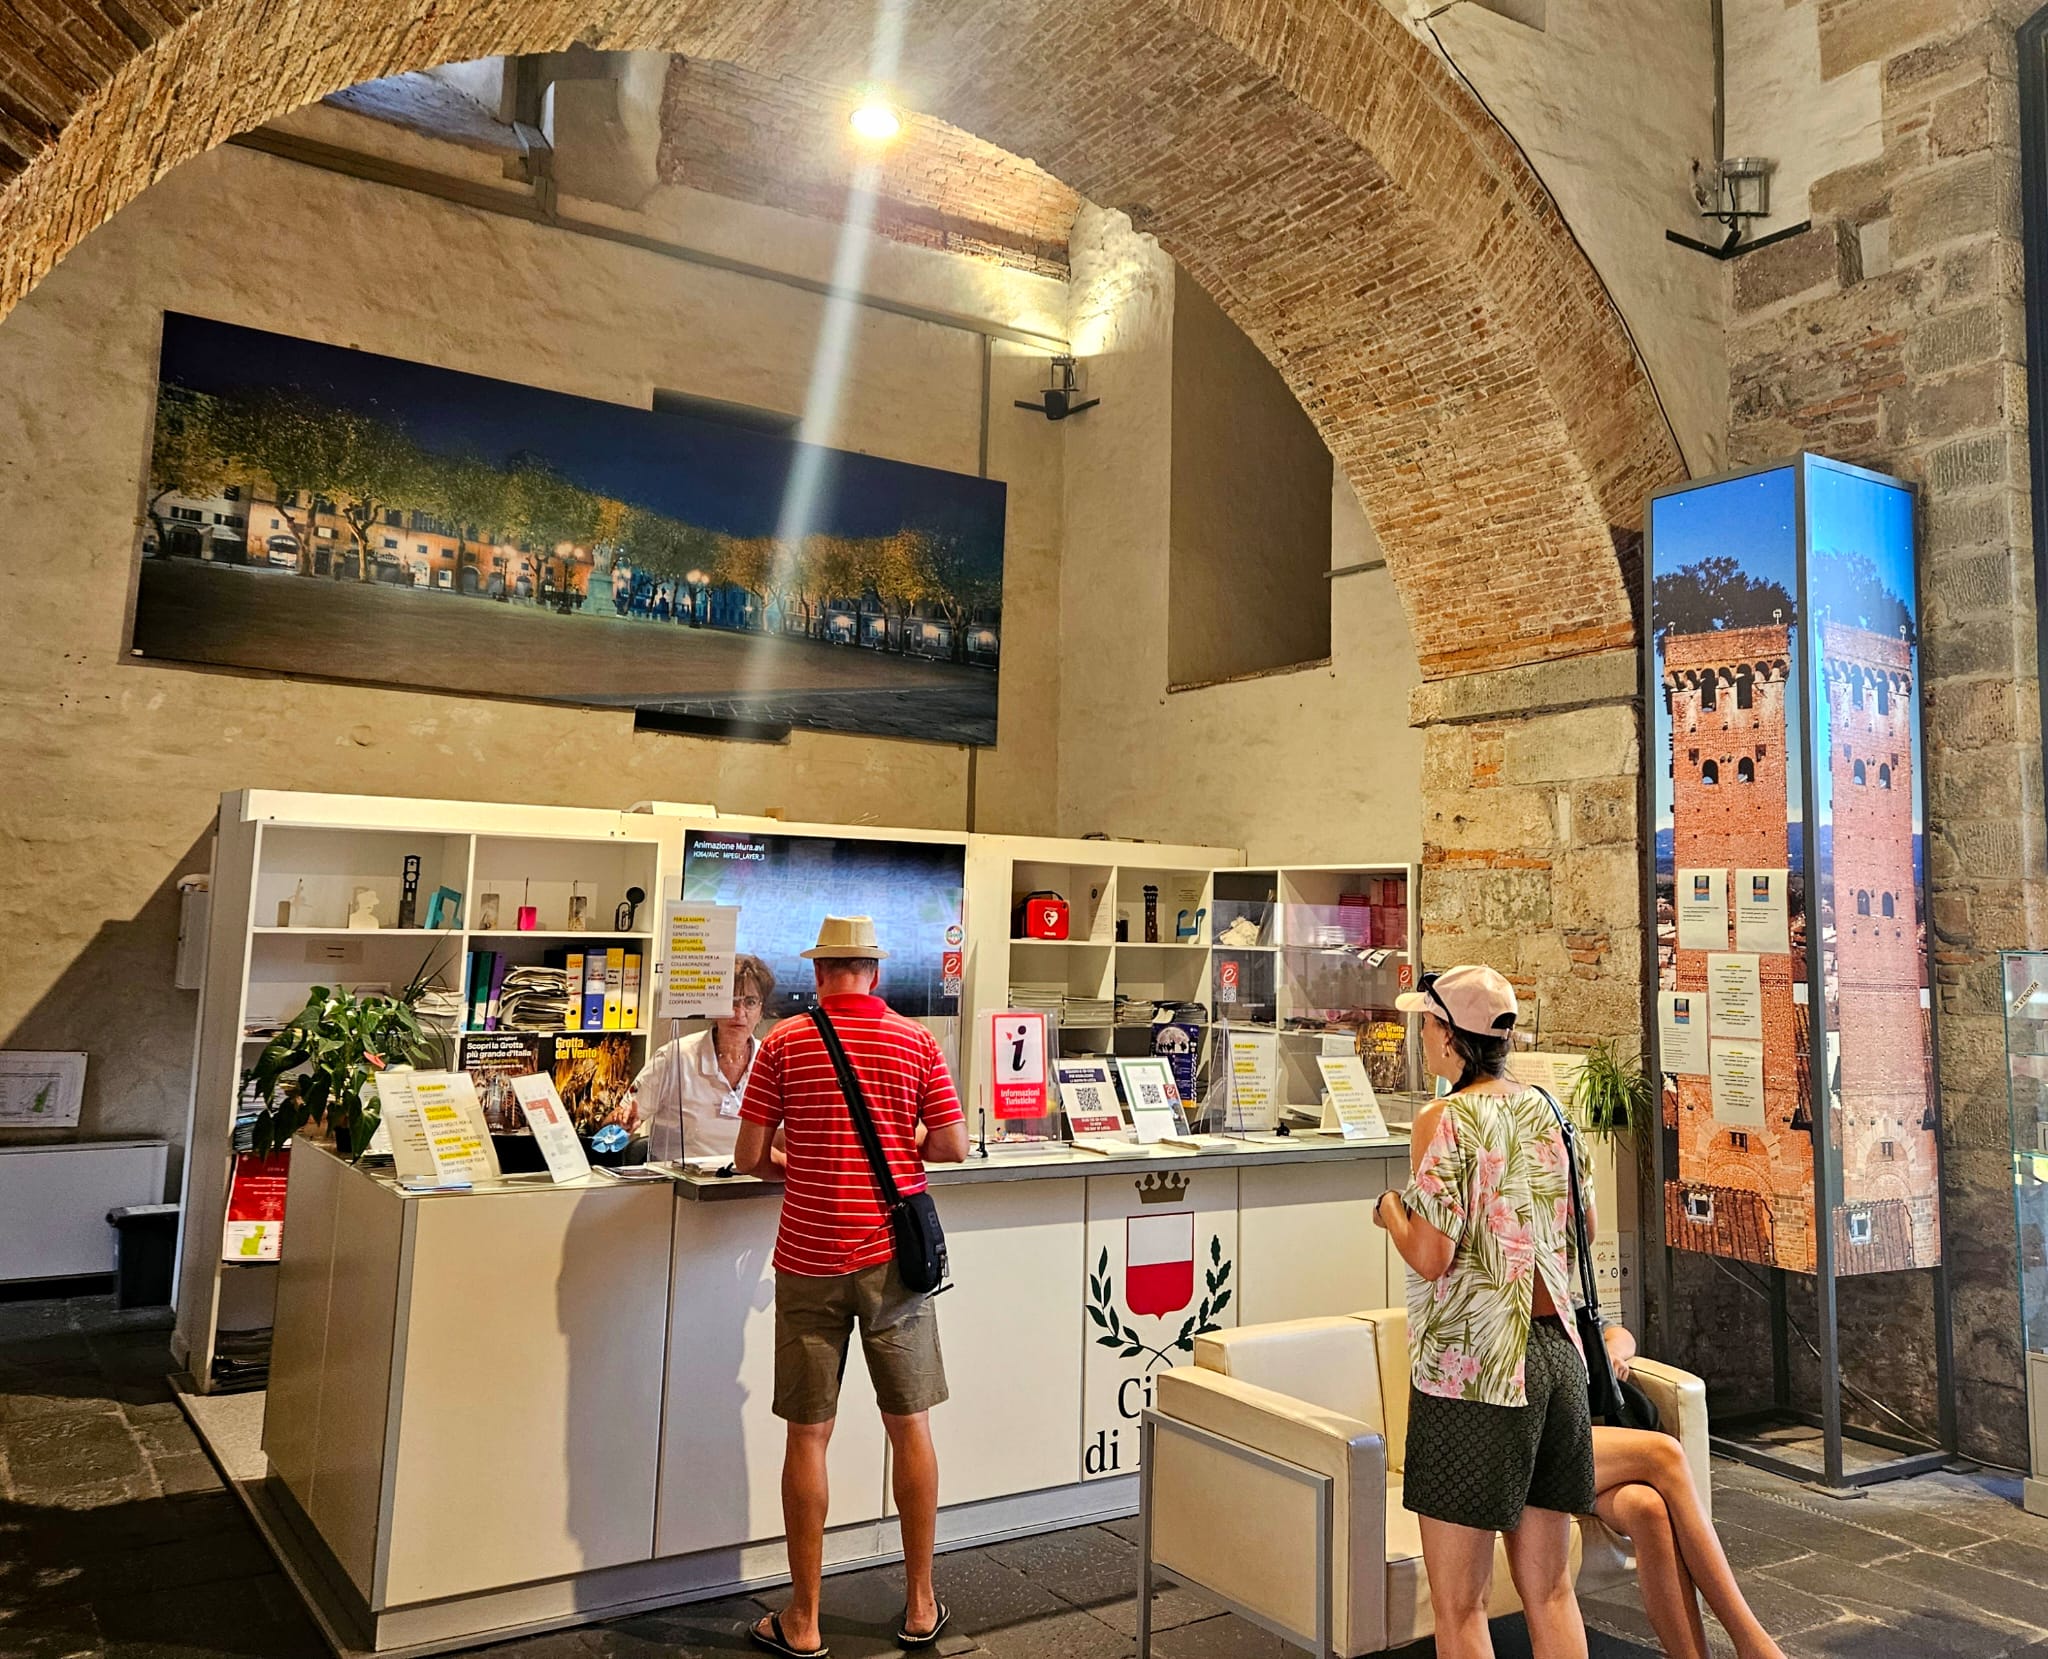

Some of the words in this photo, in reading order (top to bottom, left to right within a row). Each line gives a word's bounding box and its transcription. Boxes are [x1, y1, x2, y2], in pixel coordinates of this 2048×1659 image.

[694, 840, 735, 850] Animazione
[736, 842, 765, 852] Mura.avi
[467, 1042, 491, 1051] Scopri
[556, 1036, 584, 1048] Grotta
[467, 1051, 479, 1060] più
[480, 1050, 506, 1059] grande
[555, 1048, 569, 1060] del
[572, 1047, 597, 1059] Vento
[1001, 1087, 1040, 1097] Informazioni
[1006, 1097, 1036, 1106] Turistiche
[1118, 1375, 1153, 1419] Ci
[1085, 1428, 1121, 1475] di
